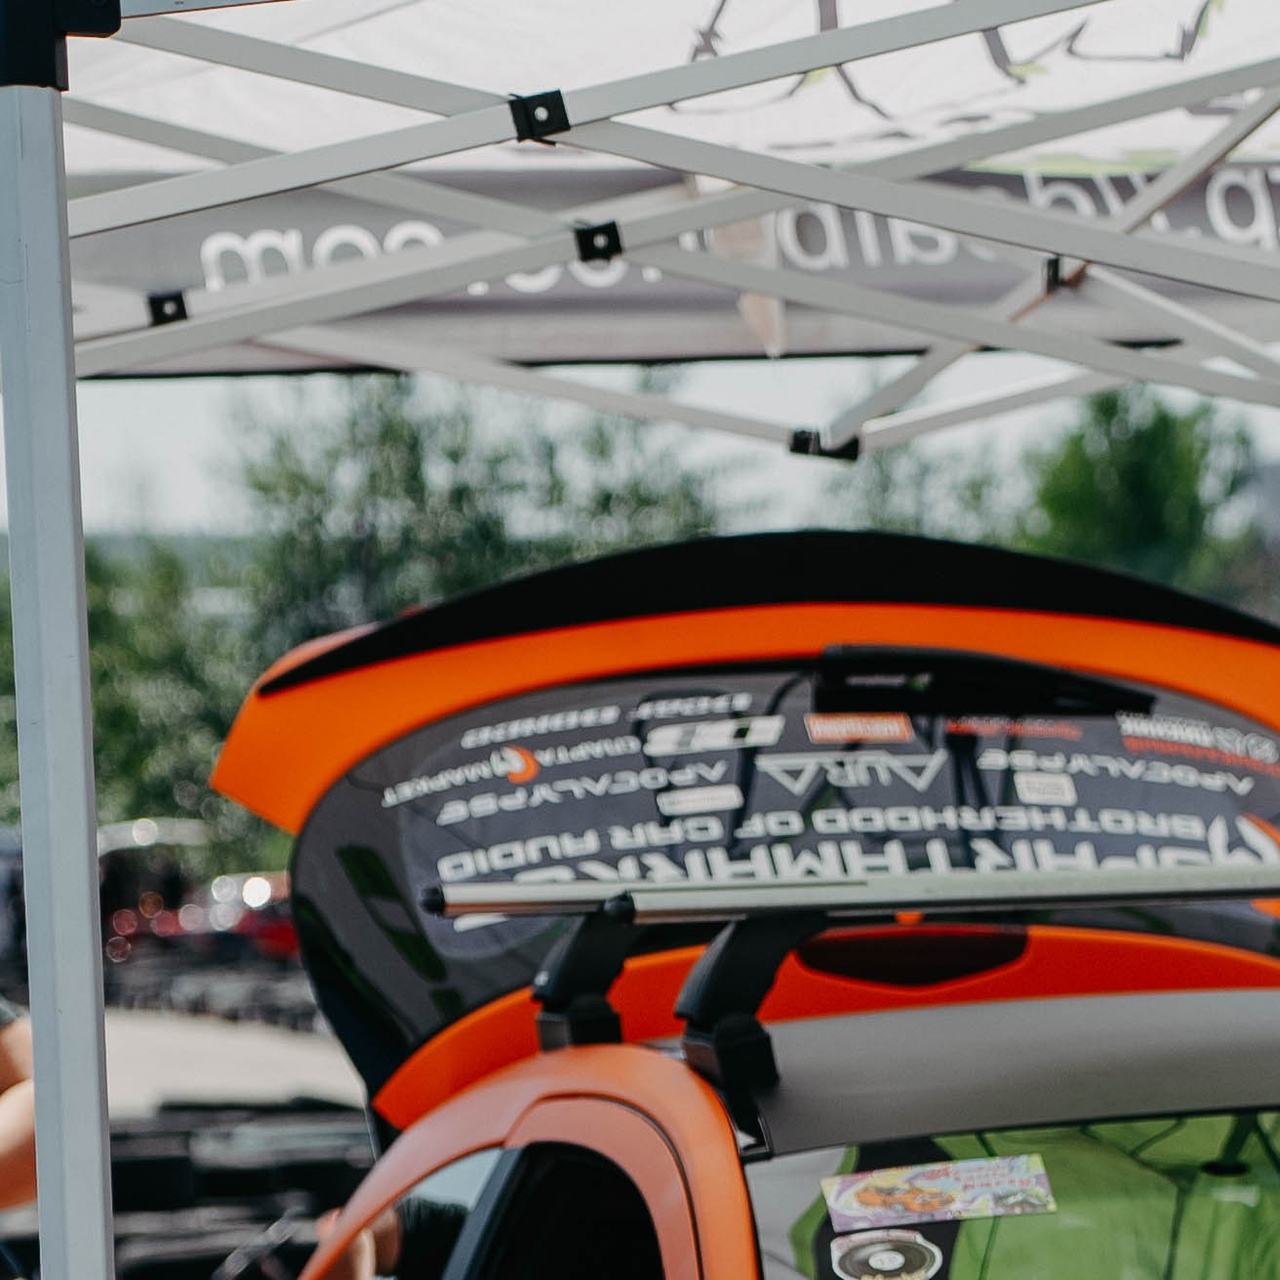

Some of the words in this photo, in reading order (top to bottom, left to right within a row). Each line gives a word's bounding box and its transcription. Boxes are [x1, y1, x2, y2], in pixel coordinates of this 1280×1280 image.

[436, 759, 727, 826] APOCALYPSE
[976, 748, 1254, 796] APOCALYPSE
[609, 815, 724, 851] CAR
[733, 810, 804, 839] OF
[811, 805, 1207, 842] BROTHERHOOD
[437, 828, 600, 883] AUDIO
